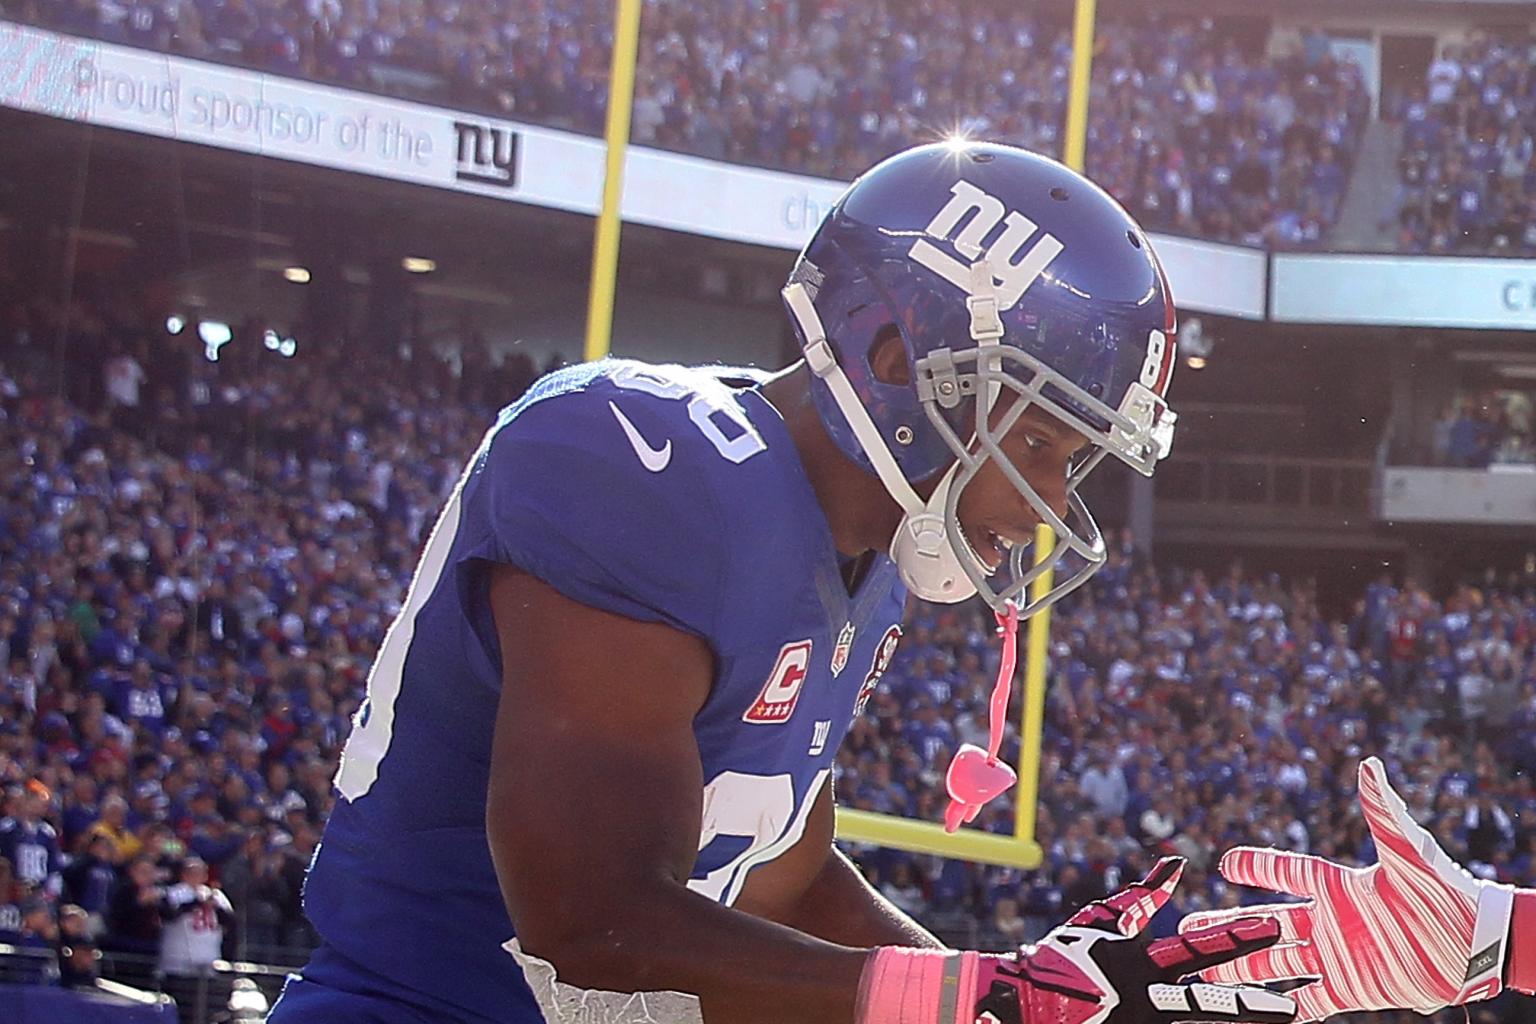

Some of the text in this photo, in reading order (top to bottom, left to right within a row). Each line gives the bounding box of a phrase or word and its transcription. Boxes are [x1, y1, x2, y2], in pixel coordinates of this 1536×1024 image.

[78, 57, 181, 119] Proud
[190, 88, 328, 143] sponsor
[333, 113, 372, 151] of
[379, 117, 433, 166] the
[764, 647, 808, 704] C
